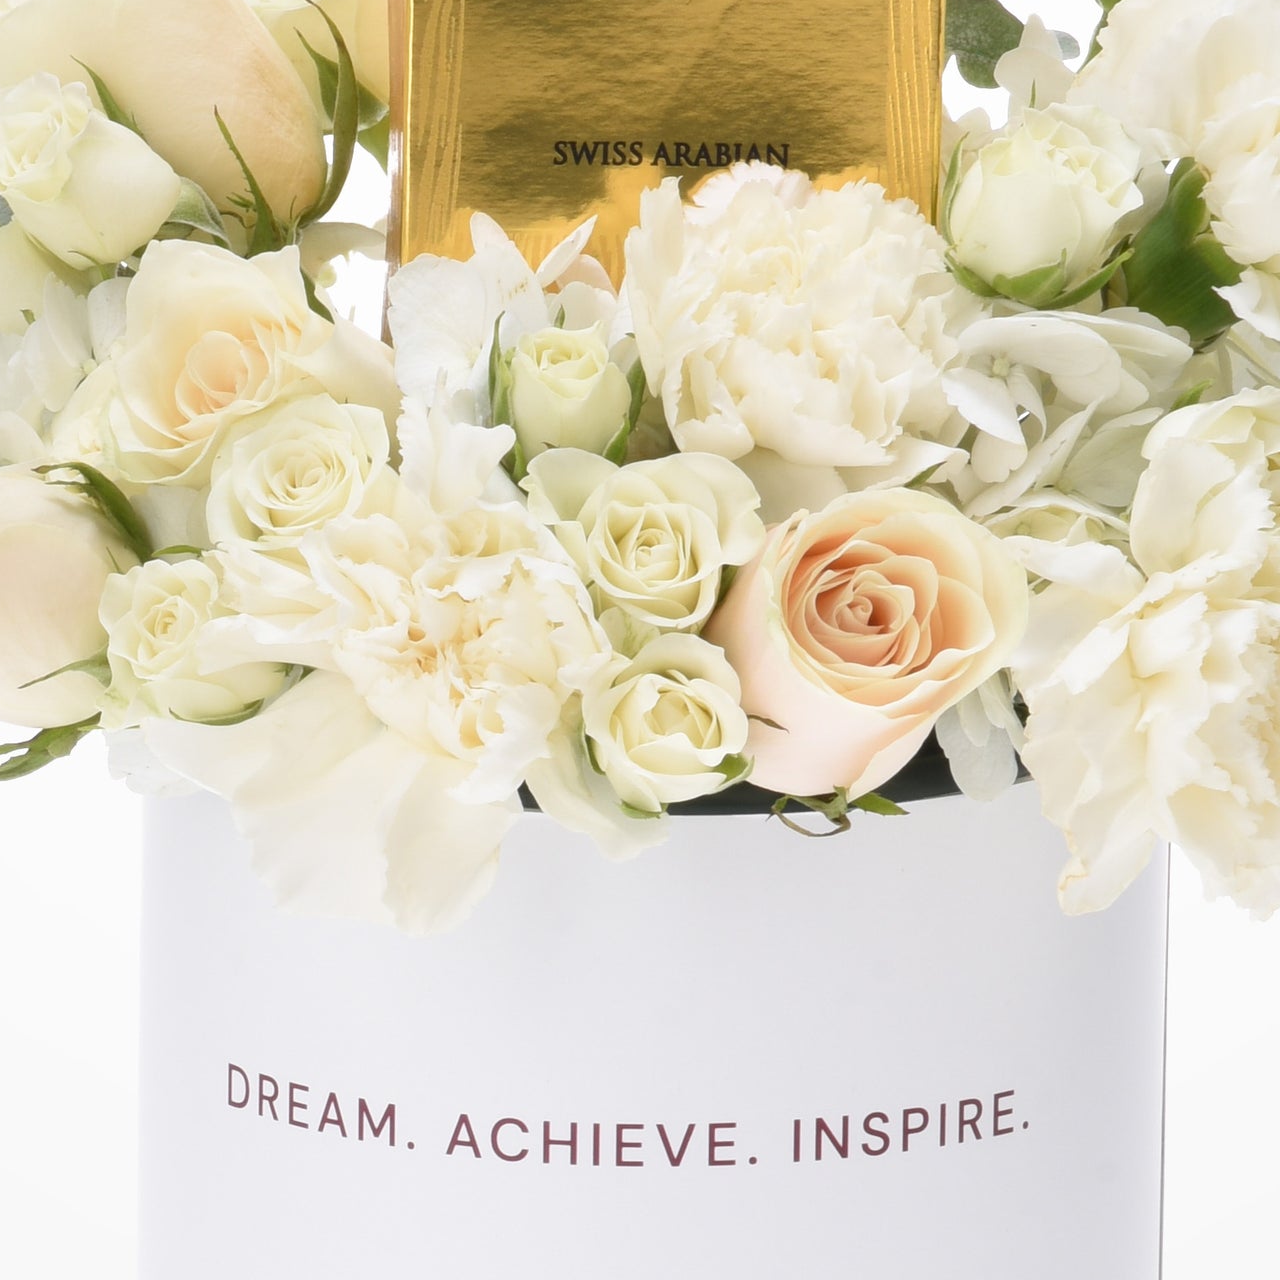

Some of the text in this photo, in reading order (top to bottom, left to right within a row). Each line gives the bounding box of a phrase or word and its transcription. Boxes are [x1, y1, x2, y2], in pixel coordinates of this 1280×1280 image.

[552, 140, 790, 168] SWISS ARABIAN
[226, 1062, 1031, 1168] DREAM. ACHIEVE. INSPIRE.
